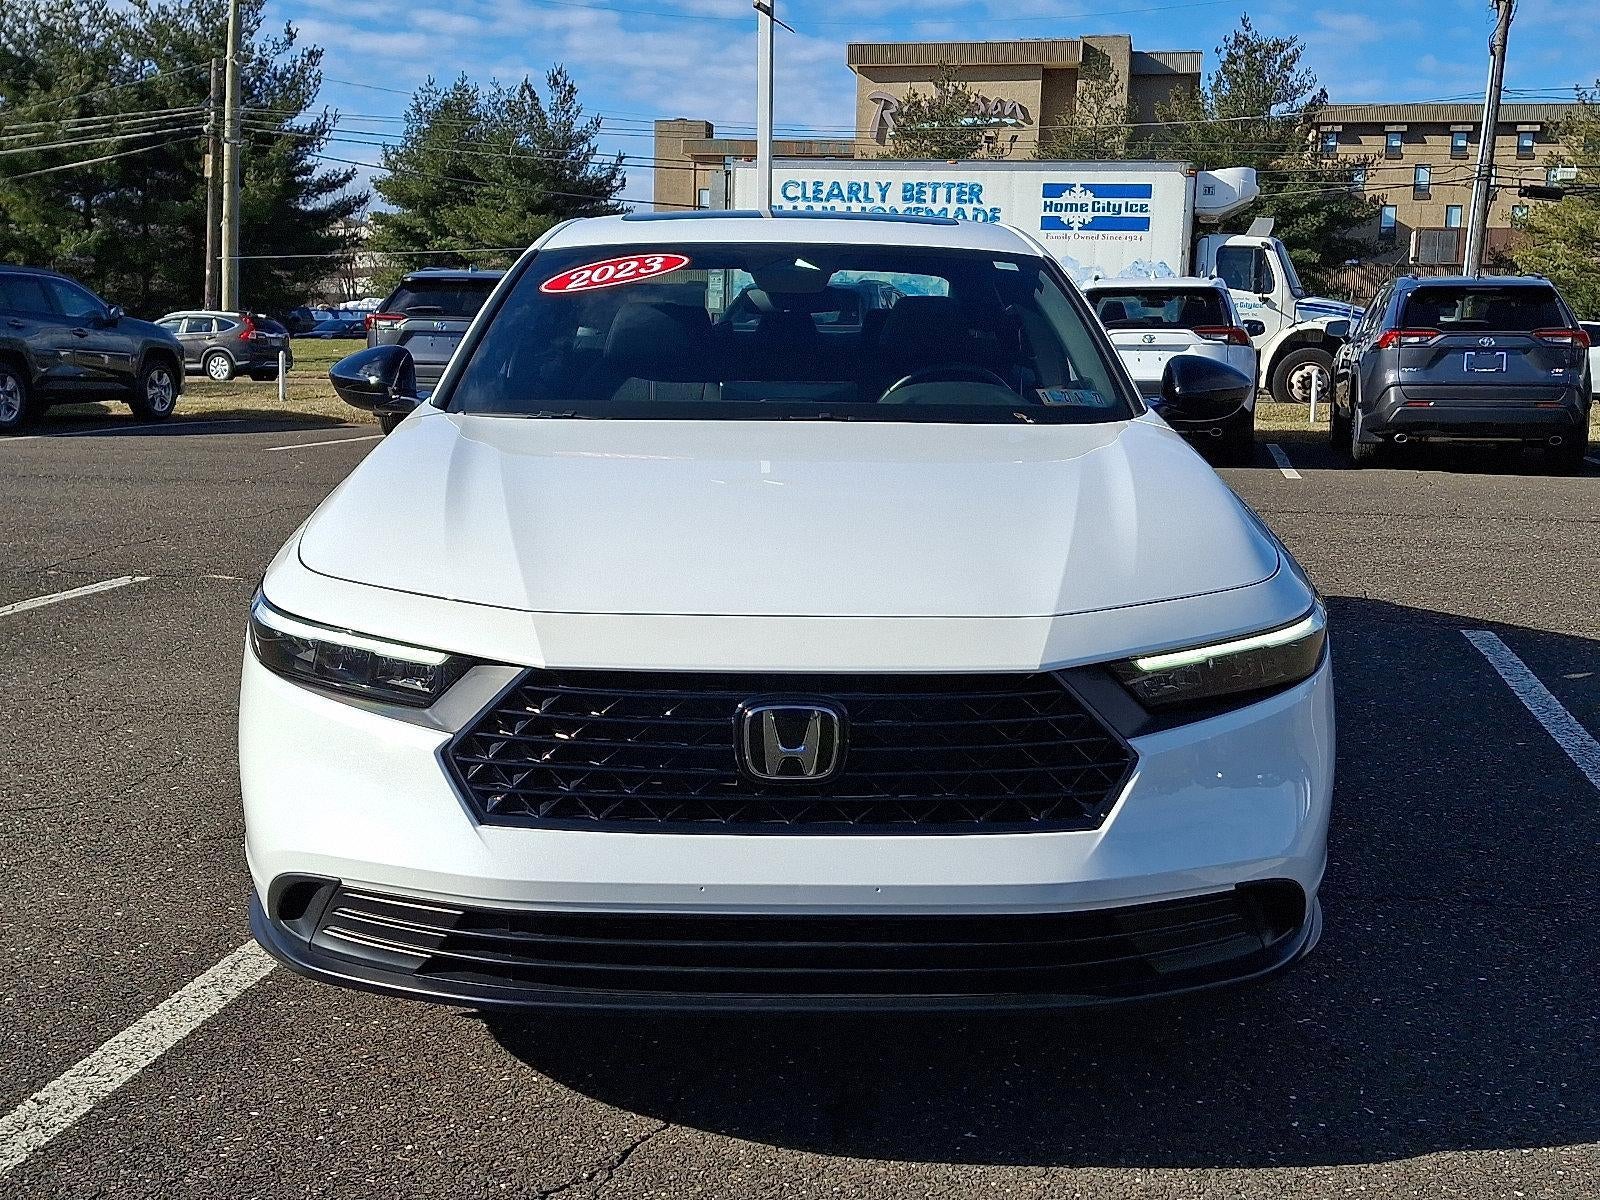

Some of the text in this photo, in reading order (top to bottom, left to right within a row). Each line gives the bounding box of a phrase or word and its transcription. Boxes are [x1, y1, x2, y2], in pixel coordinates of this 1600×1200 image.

[780, 179, 984, 205] CLEARLY BETTER
[1043, 200, 1149, 215] Home City Ice
[1045, 232, 1071, 242] Family
[1073, 232, 1100, 240] Owned
[1101, 233, 1122, 241] Since
[565, 256, 665, 290] 2023
